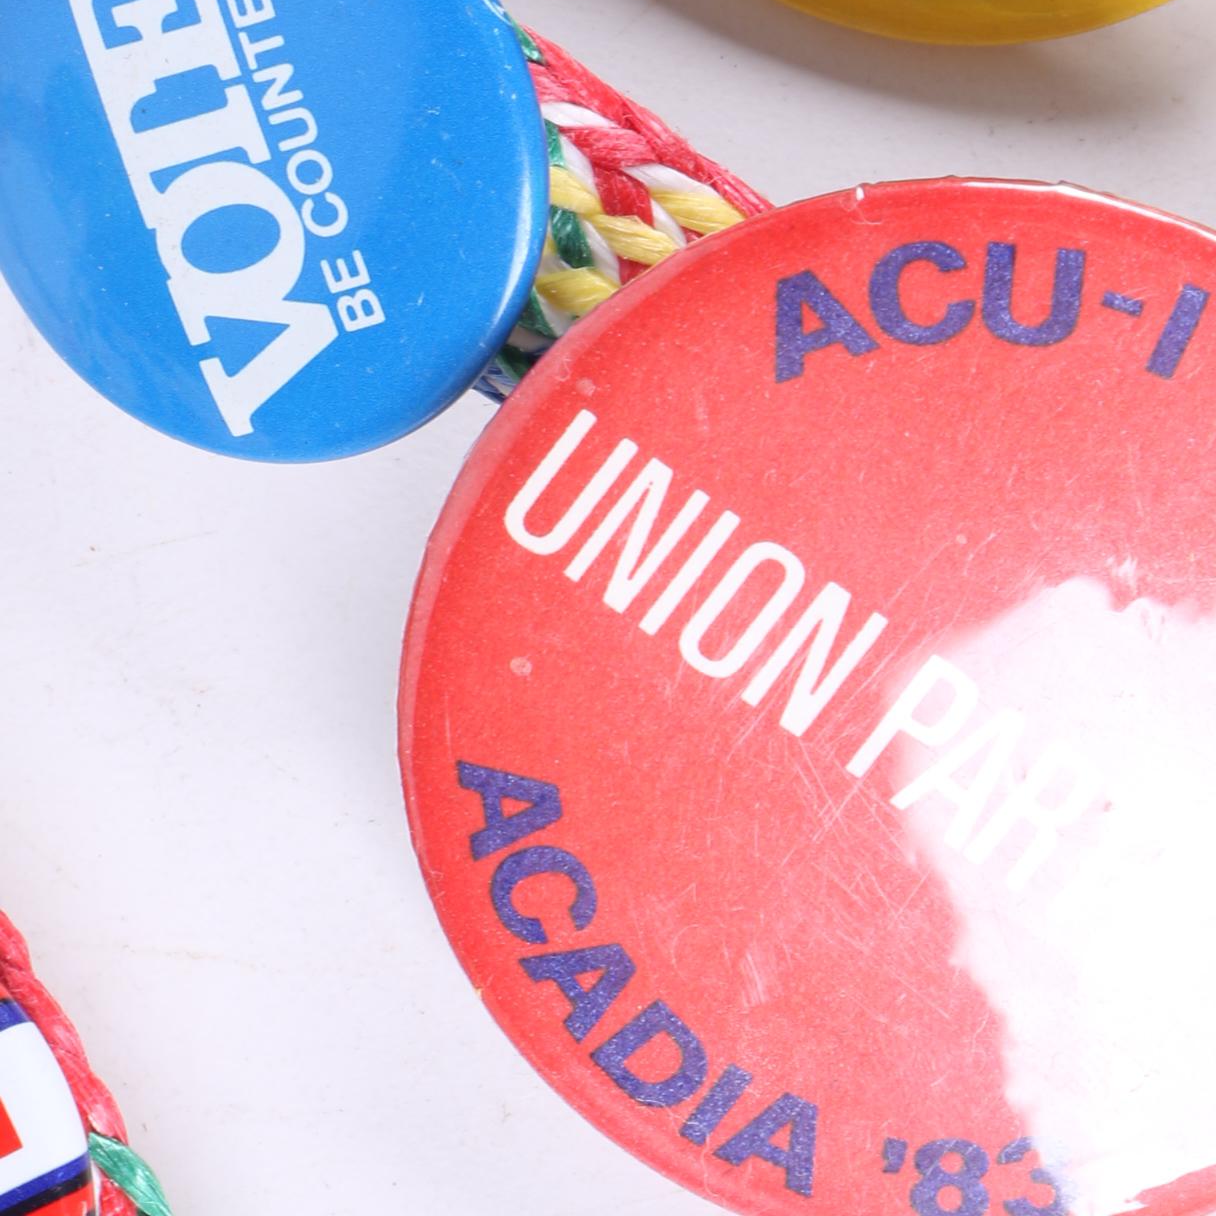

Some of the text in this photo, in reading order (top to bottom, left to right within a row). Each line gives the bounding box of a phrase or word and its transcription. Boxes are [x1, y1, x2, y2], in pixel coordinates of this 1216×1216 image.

[320, 249, 386, 332] BE
[774, 240, 1209, 384] ACU-I
[503, 409, 888, 737] UNION
[456, 759, 817, 1197] ACADIA
